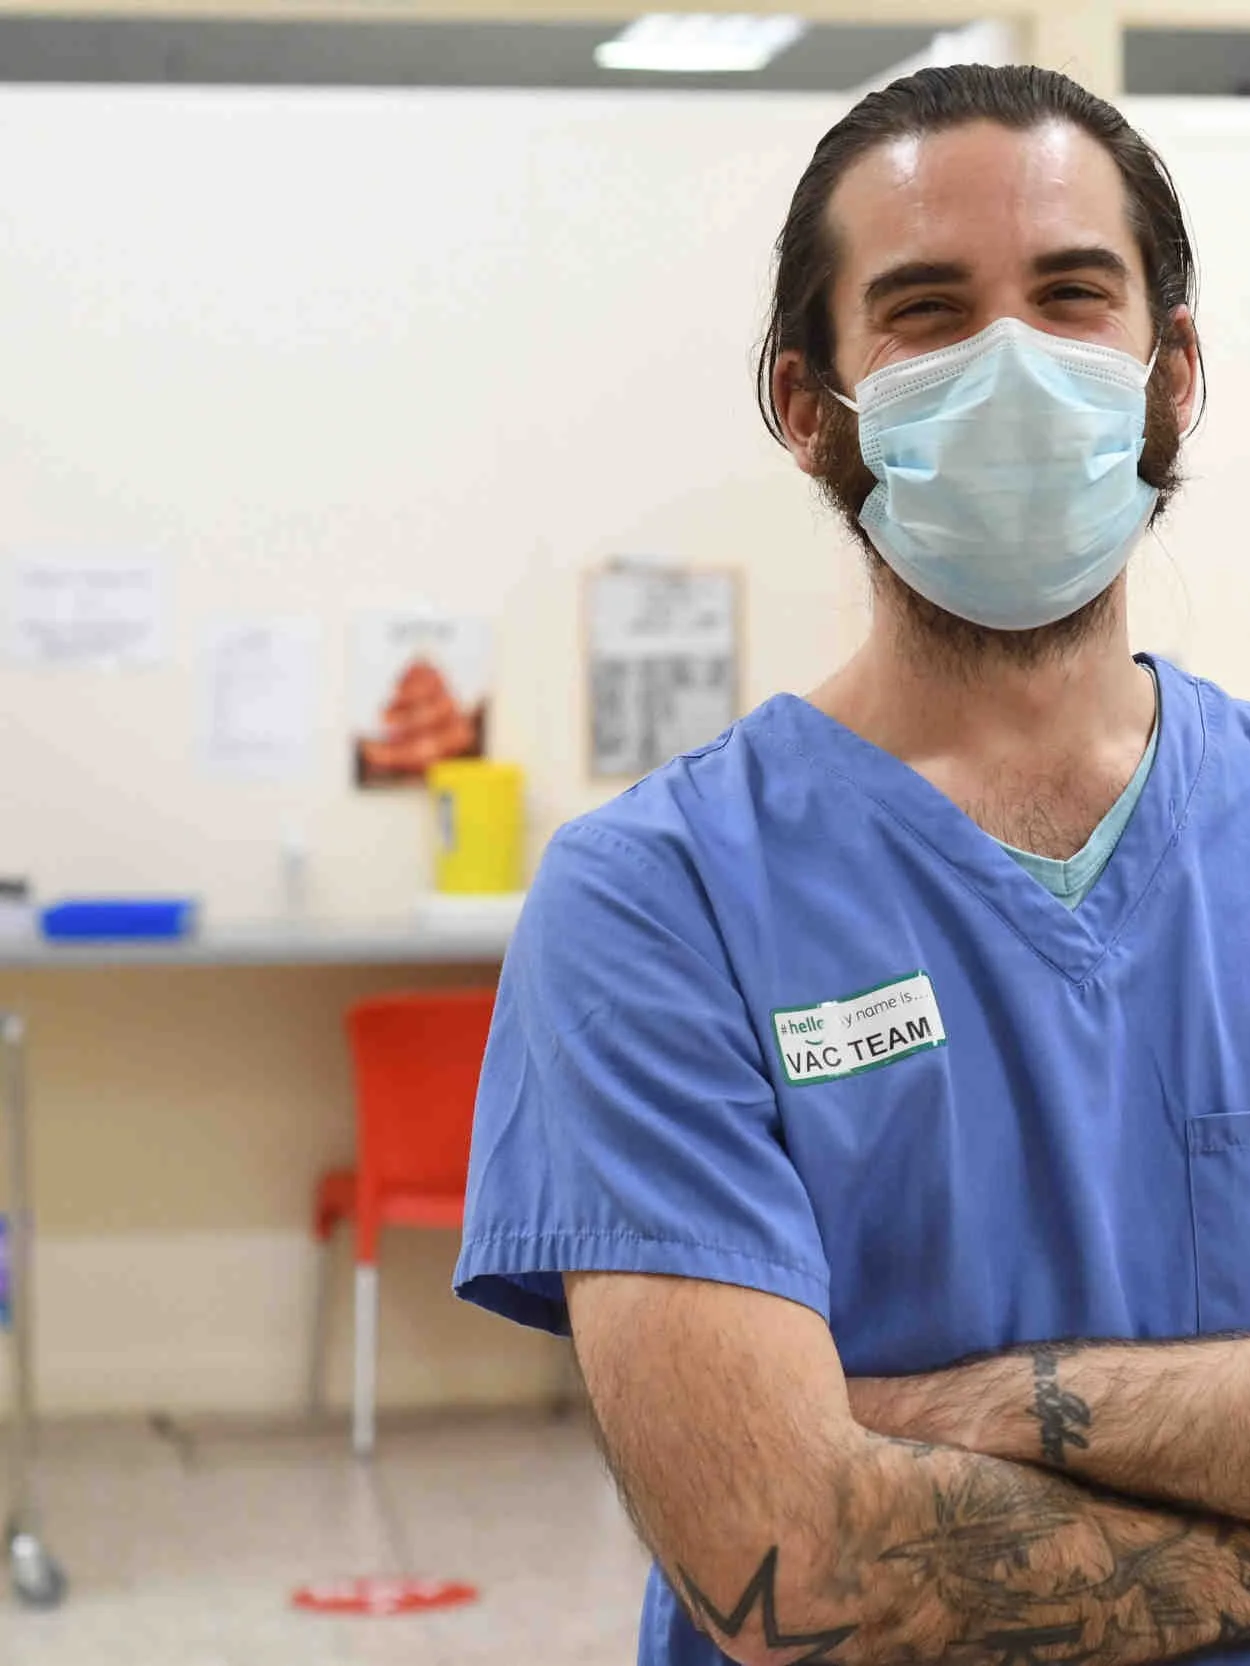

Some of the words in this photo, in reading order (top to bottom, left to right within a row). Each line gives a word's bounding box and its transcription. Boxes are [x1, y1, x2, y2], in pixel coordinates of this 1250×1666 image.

[856, 998, 897, 1021] name
[786, 1047, 842, 1074] VAC
[847, 1016, 933, 1062] TEAM
